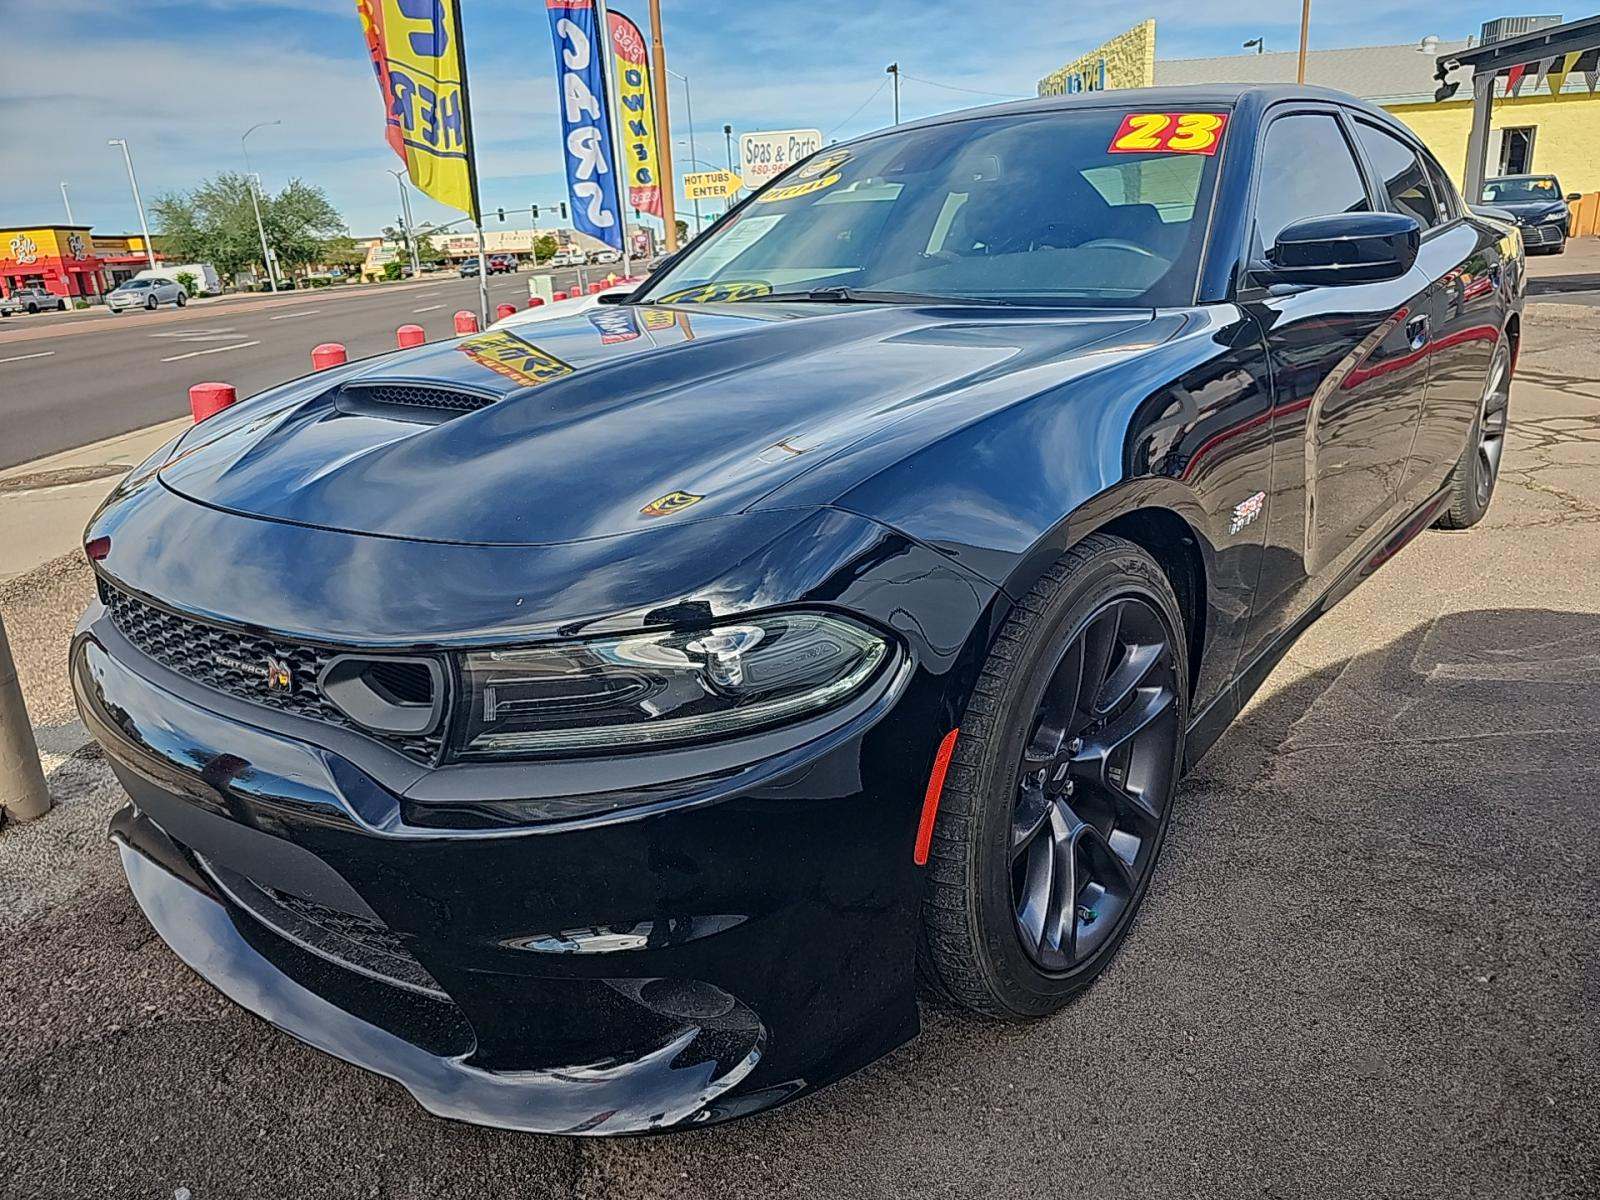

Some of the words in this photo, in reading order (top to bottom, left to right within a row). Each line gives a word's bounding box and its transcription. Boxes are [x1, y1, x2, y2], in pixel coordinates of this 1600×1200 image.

[1115, 113, 1222, 150] 23
[746, 139, 771, 164] Spas
[775, 146, 785, 162] &
[788, 136, 816, 162] Parts
[684, 174, 701, 186] HOT
[704, 173, 729, 183] TUBS
[693, 186, 727, 197] ENTER
